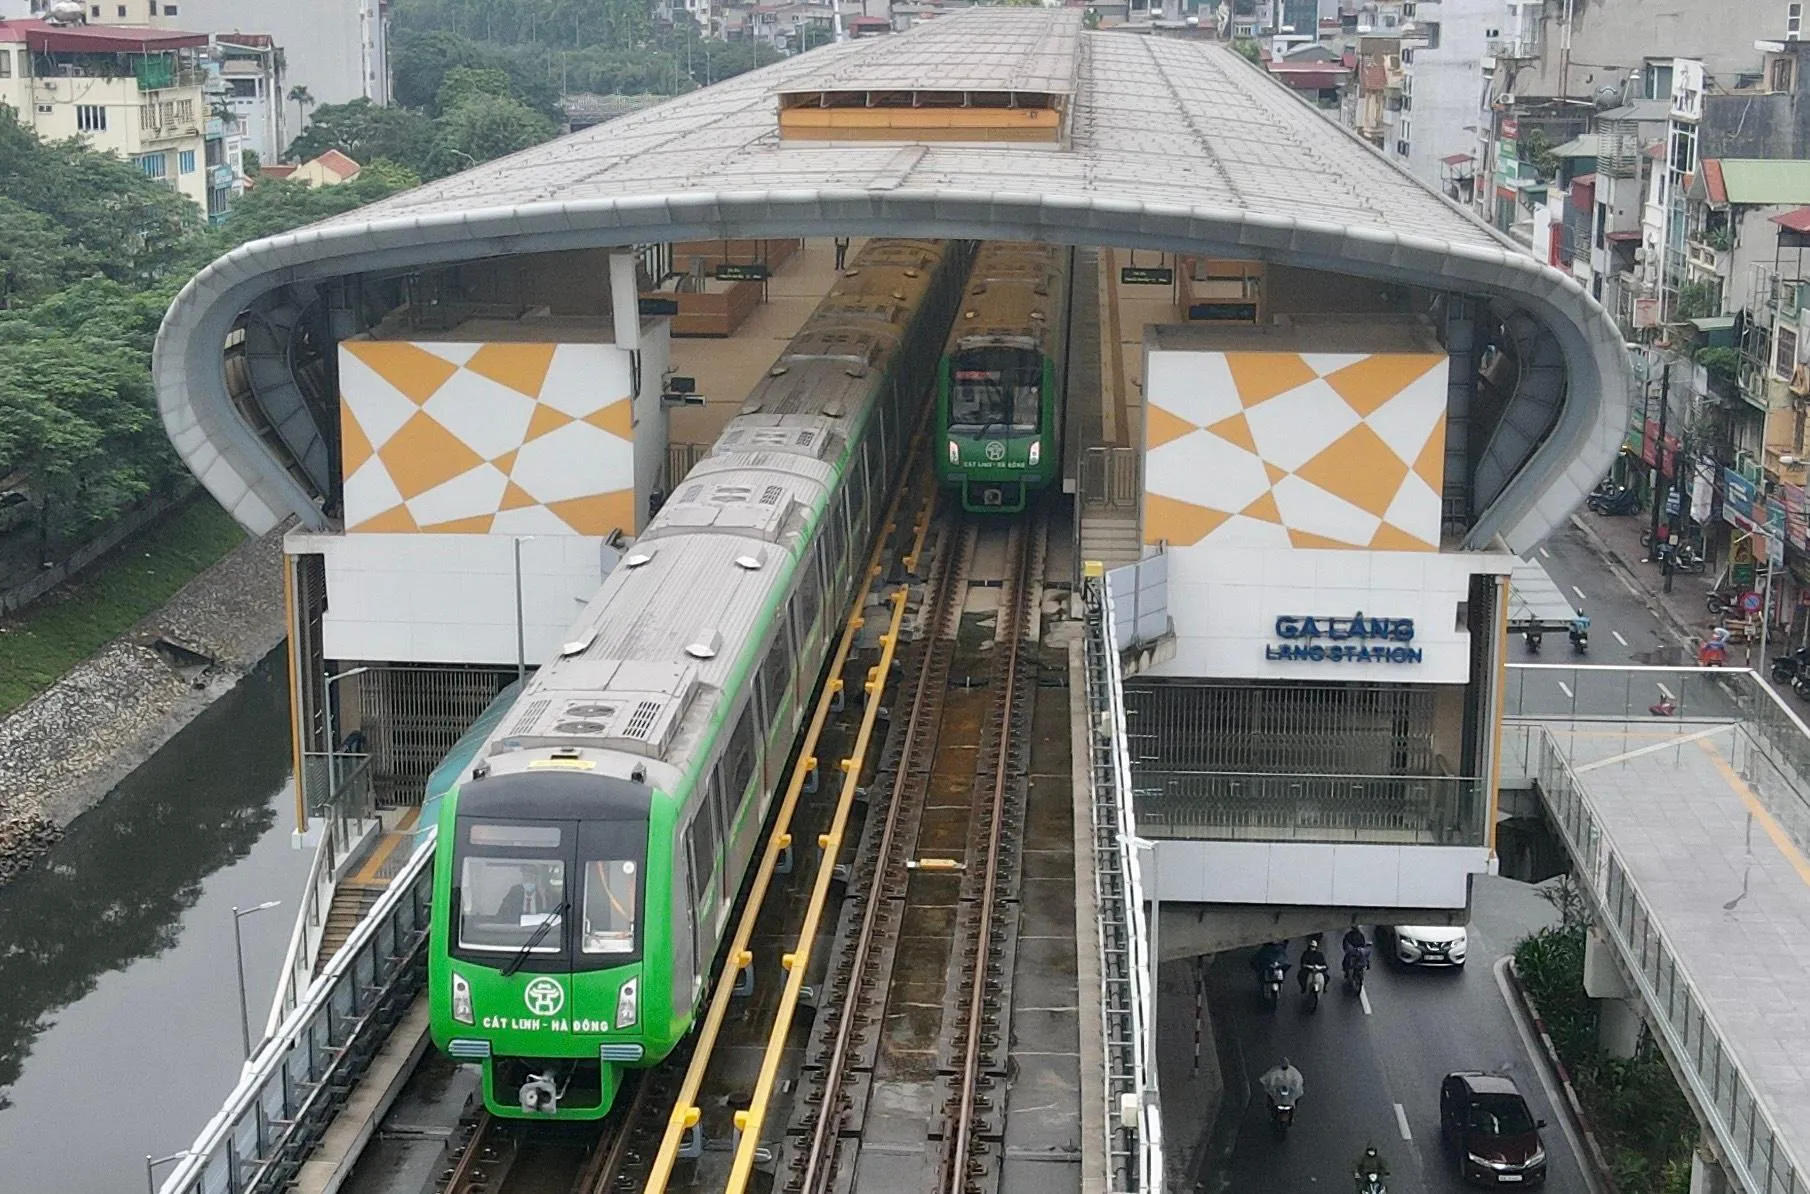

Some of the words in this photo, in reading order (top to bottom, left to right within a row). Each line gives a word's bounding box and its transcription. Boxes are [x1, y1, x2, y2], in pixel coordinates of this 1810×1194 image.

[1275, 616, 1321, 639] GA
[1265, 643, 1325, 662] LANG
[1327, 645, 1423, 664] STATION
[483, 1015, 507, 1029] CÁT
[511, 1018, 540, 1031] LINH
